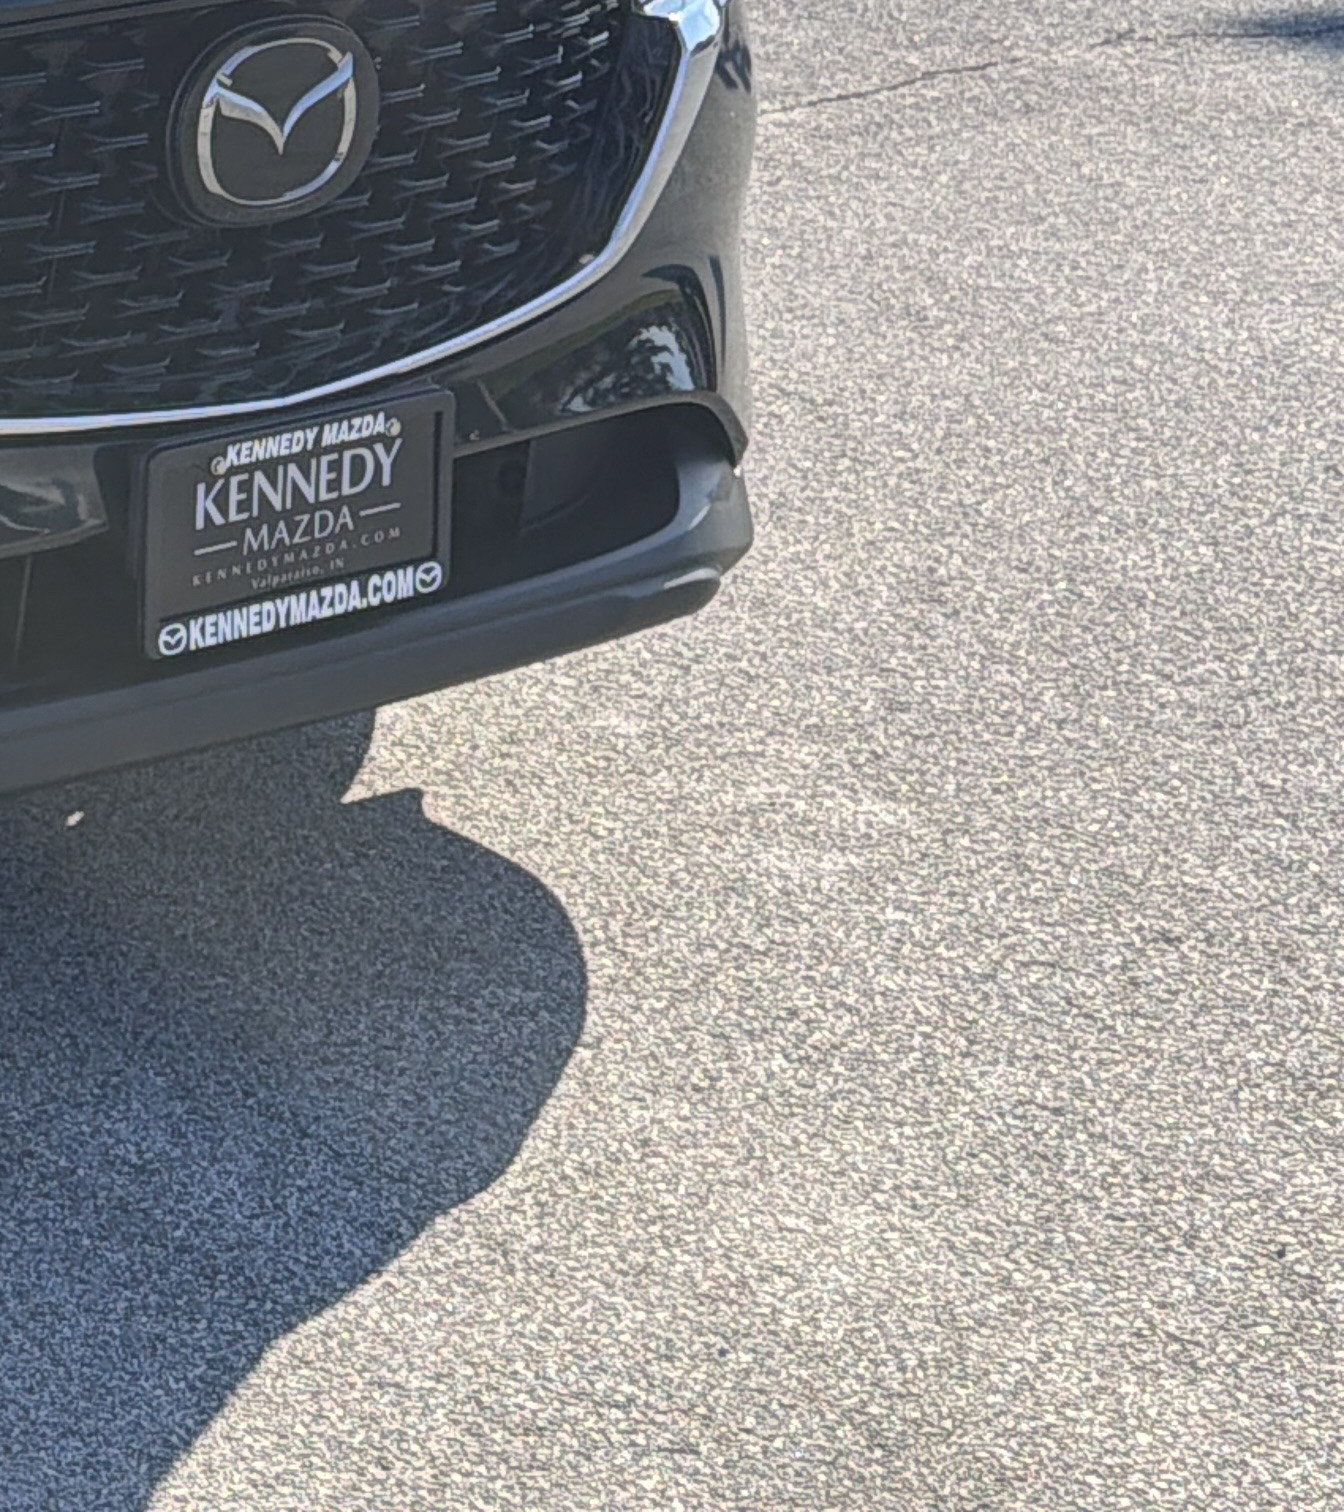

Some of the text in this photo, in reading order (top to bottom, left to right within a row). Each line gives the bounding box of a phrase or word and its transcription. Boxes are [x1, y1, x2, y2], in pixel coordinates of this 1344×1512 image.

[225, 411, 386, 467] KENNEDY MAZDA
[194, 437, 404, 531] KENNEDY
[242, 504, 355, 556] MAZDA
[188, 565, 416, 652] KENNEDYMAZDA.COM
